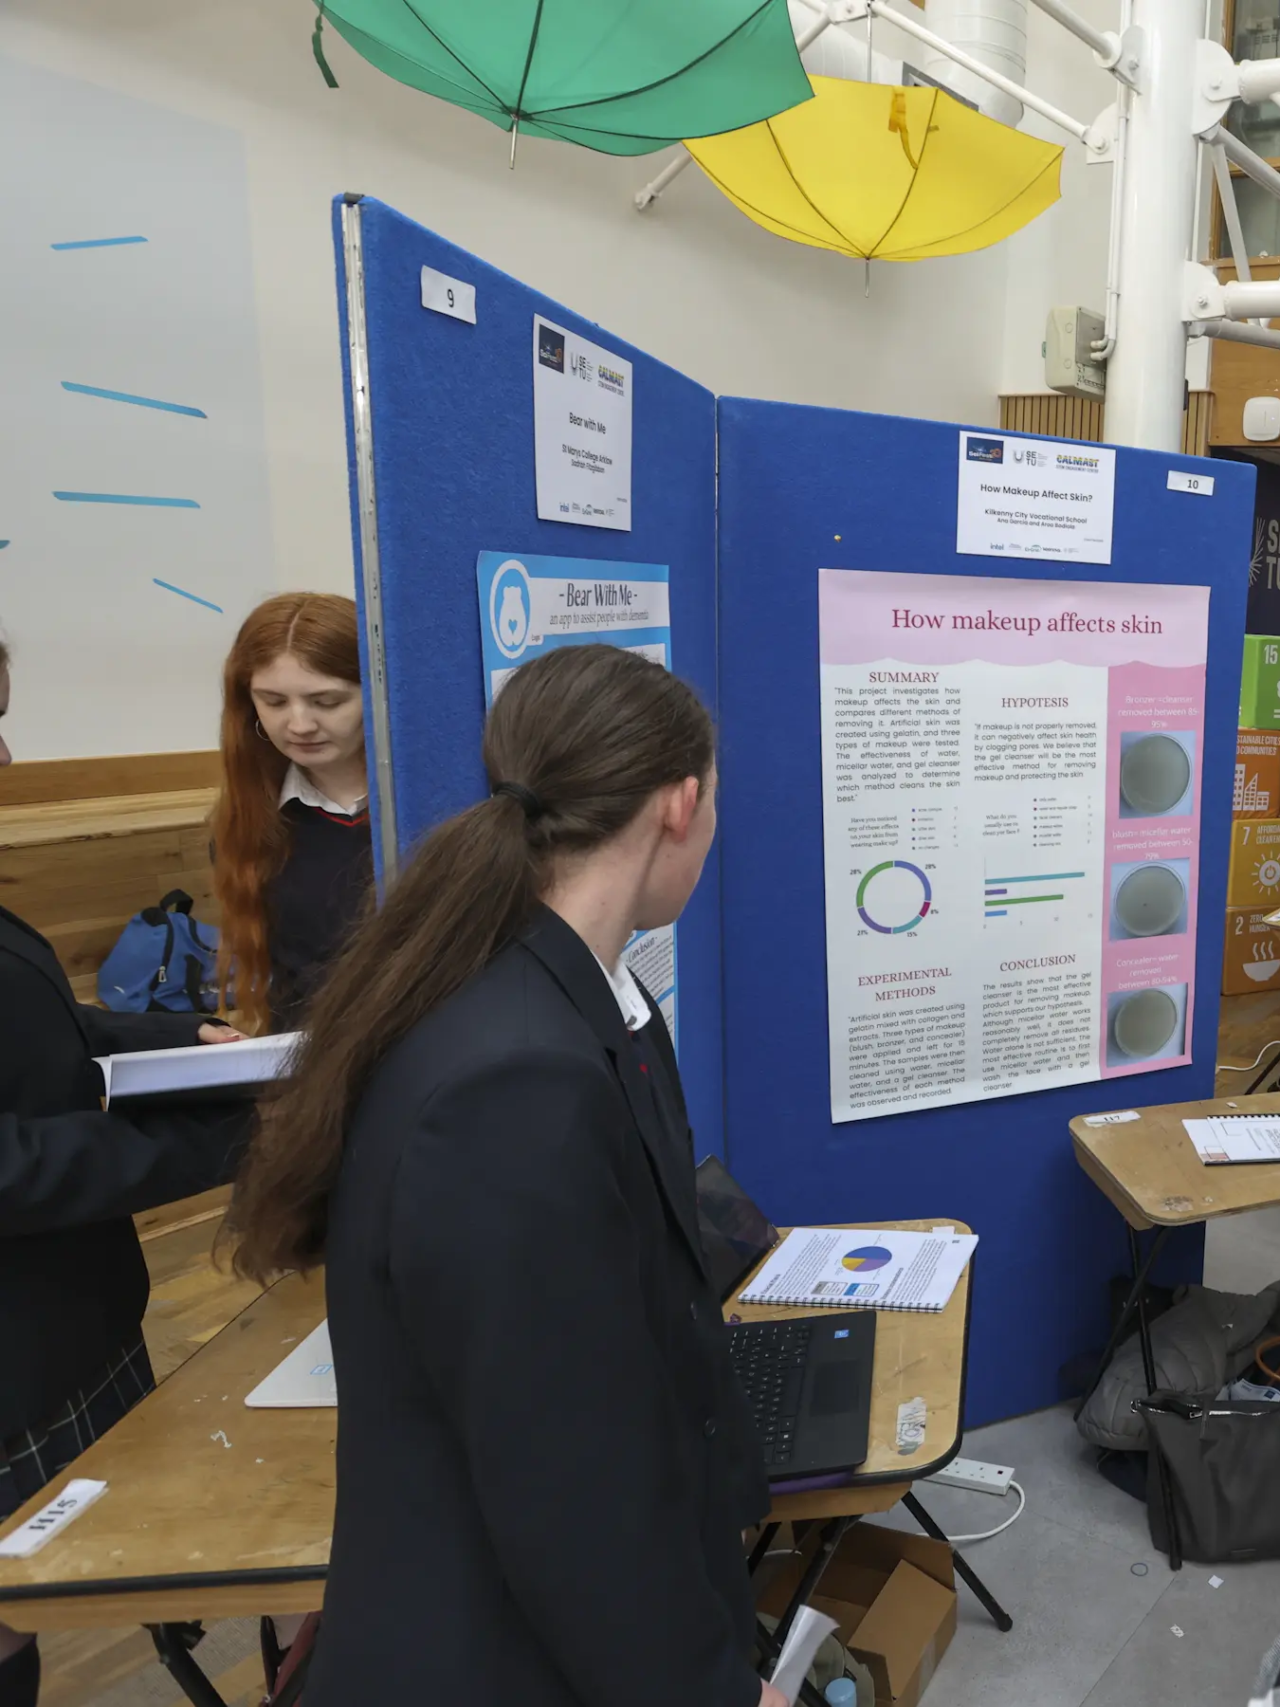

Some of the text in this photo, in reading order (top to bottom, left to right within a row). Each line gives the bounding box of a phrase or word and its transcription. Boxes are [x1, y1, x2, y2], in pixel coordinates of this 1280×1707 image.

[447, 289, 455, 308] 9
[569, 412, 606, 434] Bear with Me
[582, 449, 598, 463] College
[1056, 455, 1099, 468] CALMAST
[1187, 479, 1199, 490] 10
[981, 484, 1093, 502] How Makeup Affect Skin?
[985, 509, 1013, 518] Kilkenny
[1030, 513, 1064, 522] Vocational
[1066, 516, 1087, 524] School
[567, 583, 632, 607] Bear With Me
[550, 609, 649, 629] an app to assist people with dementia
[892, 608, 1163, 636] How makeup affects skin
[1264, 645, 1278, 665] 15
[869, 671, 939, 683] SUMMARY
[859, 688, 887, 696] project
[893, 687, 939, 696] investigates
[835, 698, 868, 707] makeup
[1001, 697, 1069, 708] HYPOTESIS
[835, 709, 875, 717] compares
[1118, 709, 1153, 717] removed
[1154, 708, 1186, 716] between
[835, 720, 873, 728] removing
[983, 723, 1012, 731] makeup
[1035, 722, 1063, 730] properly
[869, 731, 890, 739] using
[1265, 736, 1280, 745] CITIES
[836, 742, 857, 750] types
[875, 740, 907, 749] makeup
[1241, 746, 1276, 755] COMMUNITIES
[860, 751, 911, 759] effectiveness
[1243, 827, 1250, 845] 7
[1256, 836, 1273, 844] CLEAN
[1235, 916, 1244, 935] 2
[1000, 954, 1076, 972] CONCLUSION
[858, 967, 952, 987] EXPERIMENTAL
[1000, 980, 1022, 989] results
[1027, 978, 1044, 986] show
[1048, 975, 1062, 983] that
[875, 985, 936, 1002] METHODS
